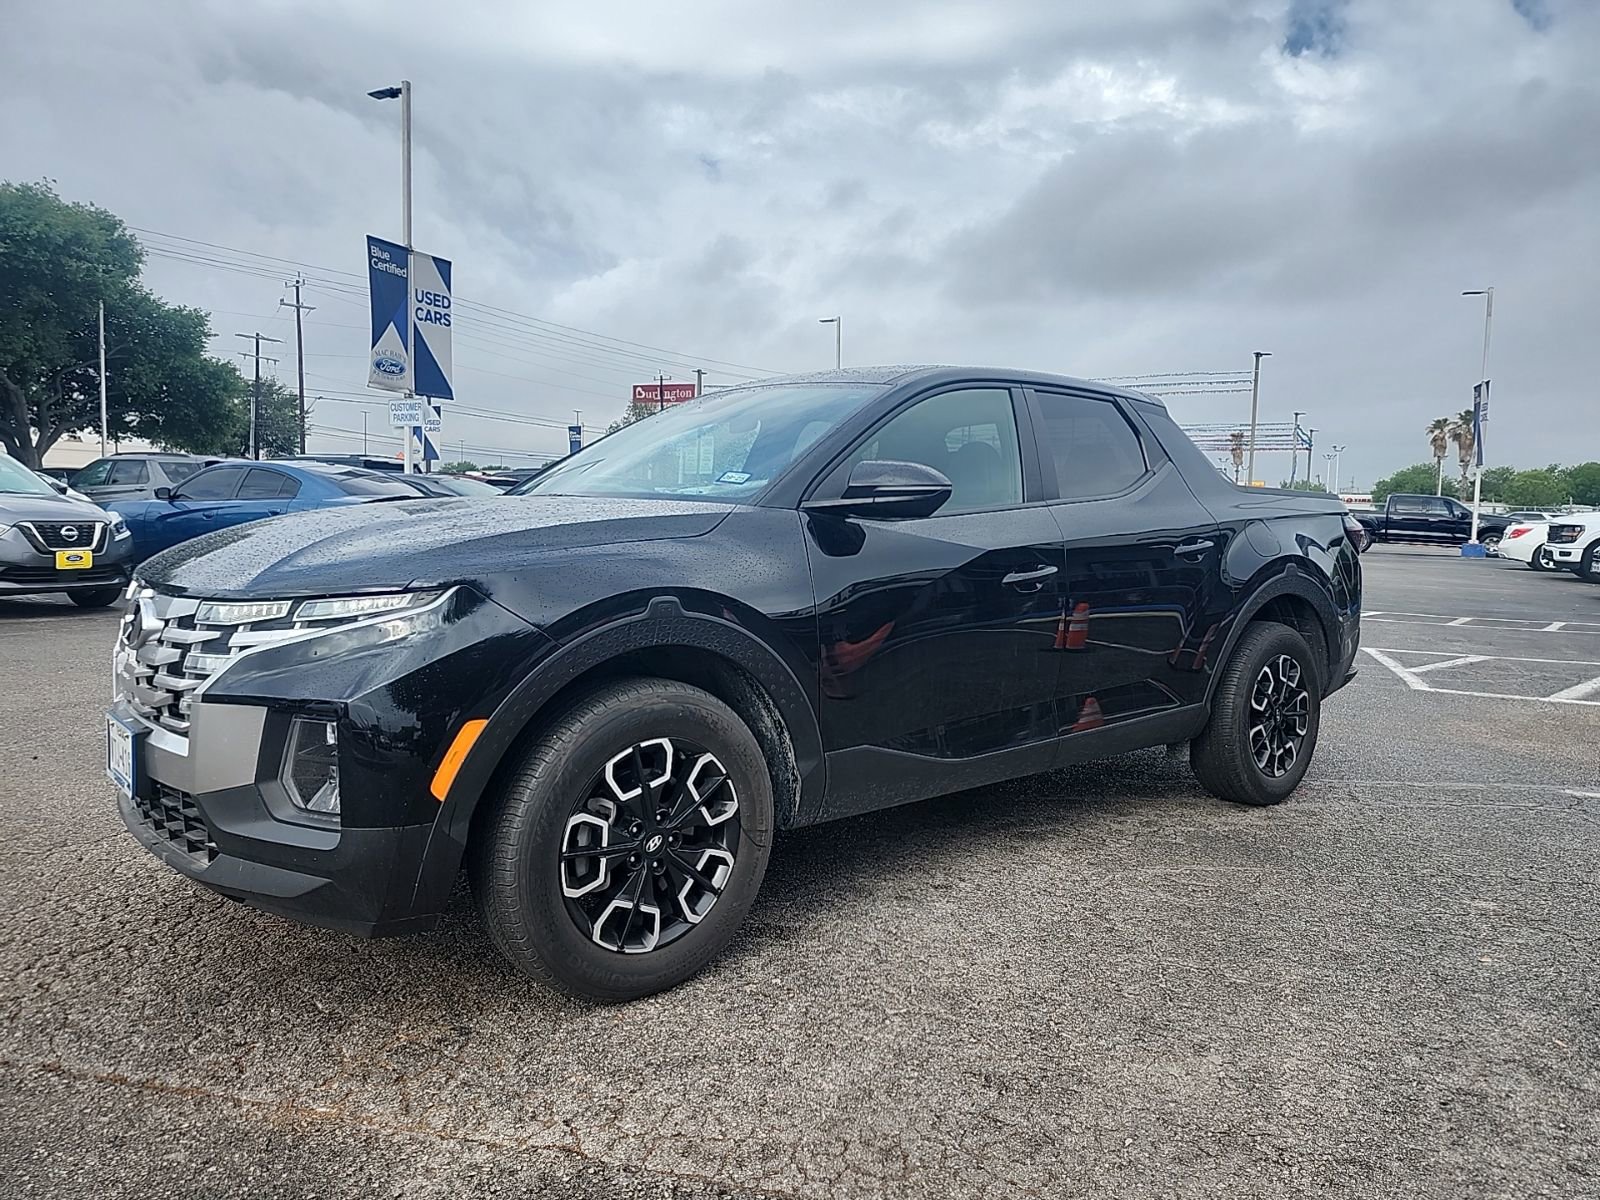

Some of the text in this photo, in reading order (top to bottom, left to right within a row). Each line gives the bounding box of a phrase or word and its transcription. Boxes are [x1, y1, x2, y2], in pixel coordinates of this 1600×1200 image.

[370, 245, 390, 260] Blue
[371, 258, 407, 278] Certified
[415, 288, 451, 309] USED
[415, 307, 451, 327] CARS
[380, 359, 402, 373] Ford
[635, 386, 692, 402] Burlngton
[390, 402, 421, 411] CUSTOMER
[393, 413, 420, 421] PARKING
